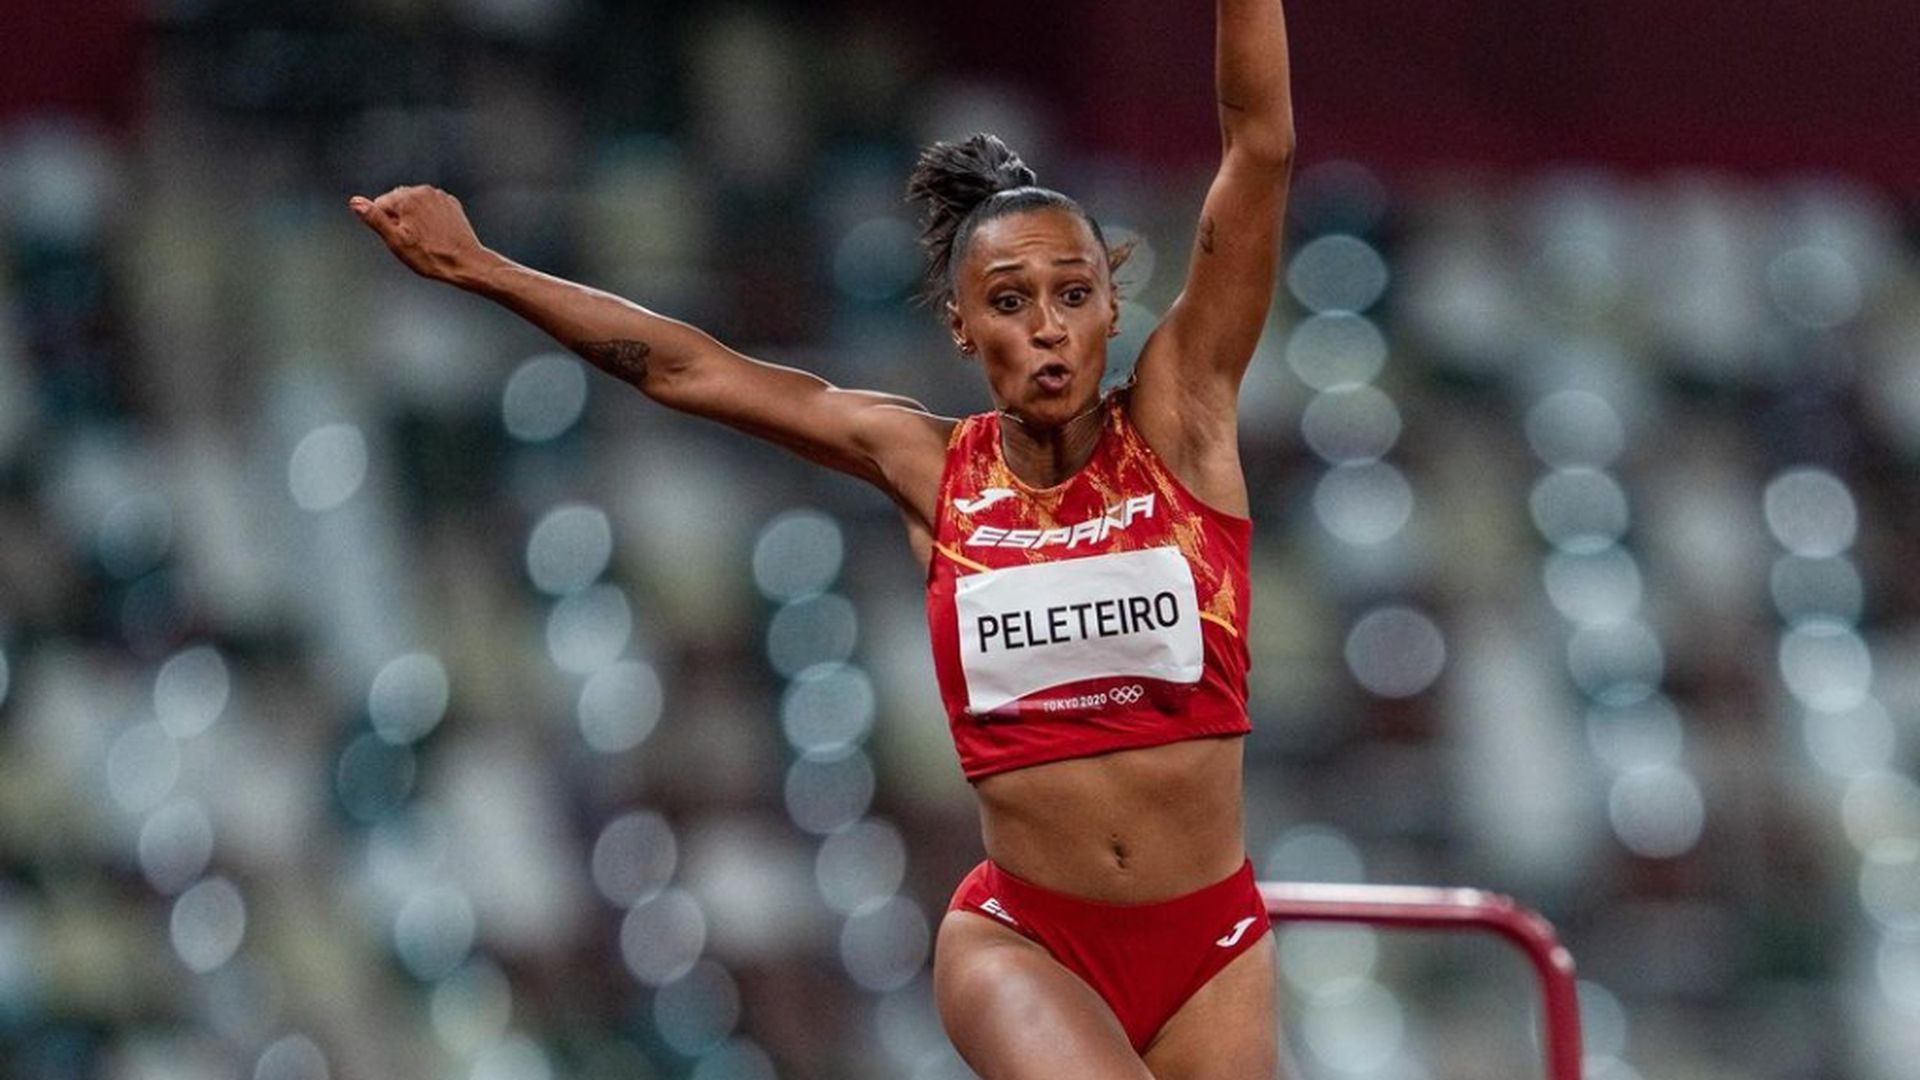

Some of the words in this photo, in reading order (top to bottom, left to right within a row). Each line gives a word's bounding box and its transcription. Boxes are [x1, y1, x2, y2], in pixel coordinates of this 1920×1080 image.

[977, 591, 1179, 653] PELETEIRO
[1043, 697, 1079, 712] TOKYO
[1080, 693, 1107, 707] 2020
